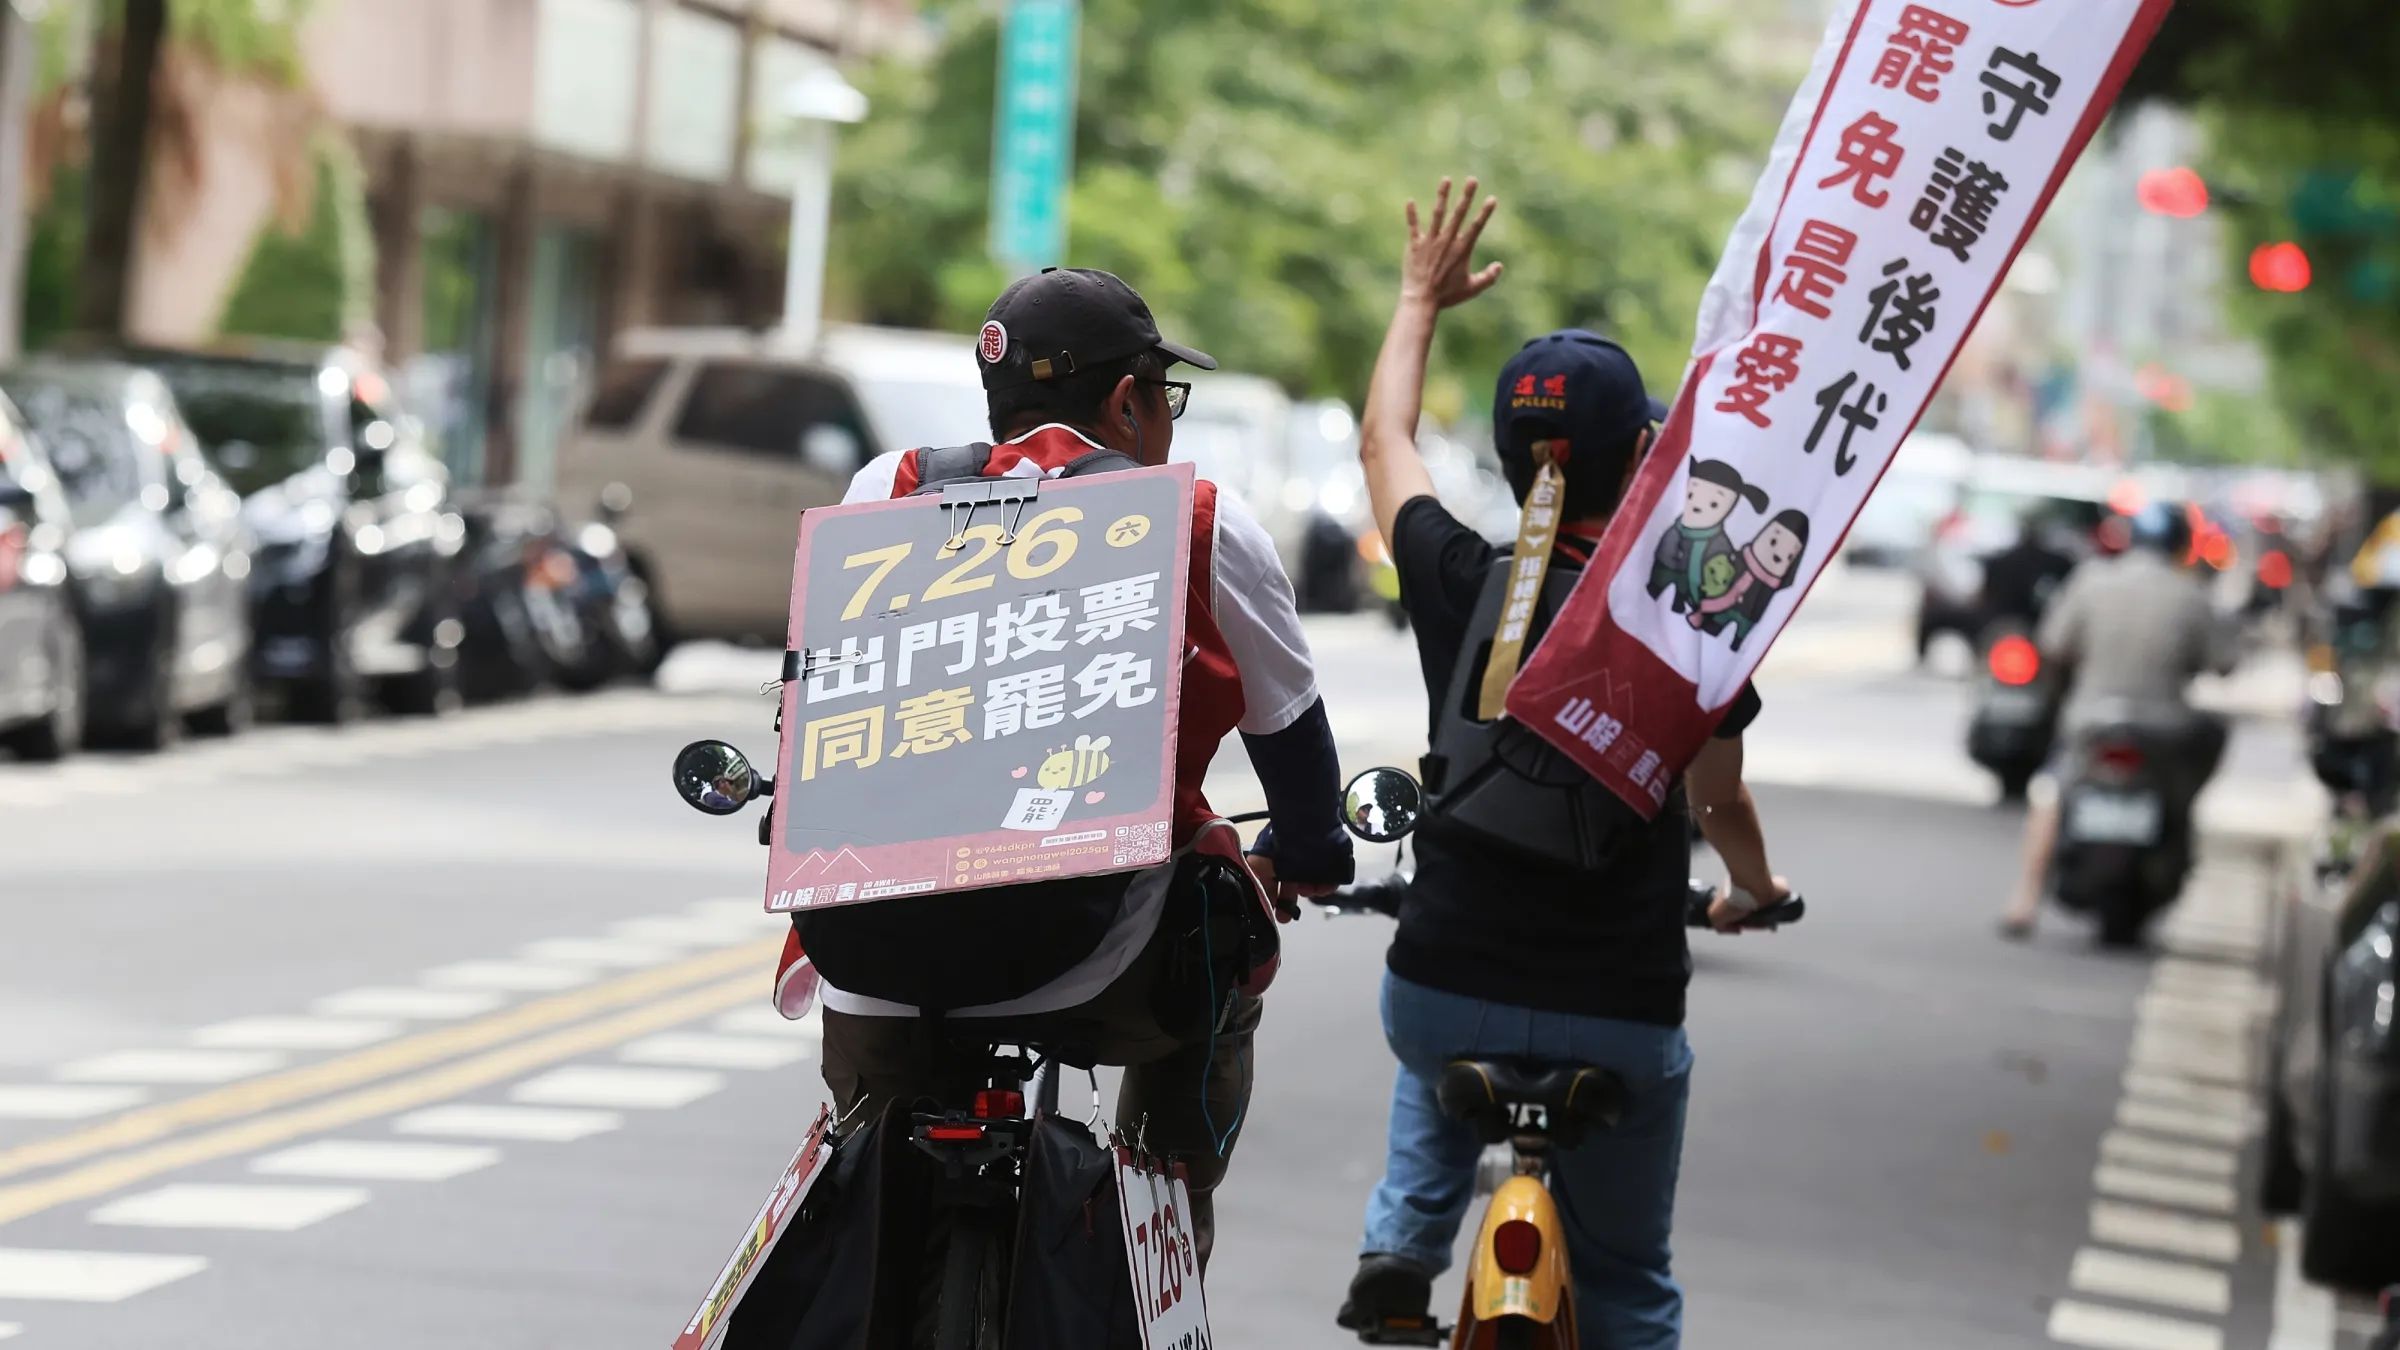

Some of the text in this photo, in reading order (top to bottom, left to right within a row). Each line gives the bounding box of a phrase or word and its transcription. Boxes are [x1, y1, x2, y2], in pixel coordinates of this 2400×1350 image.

[1715, 4, 1970, 429] 罷免是愛
[1804, 46, 2061, 476] 守護後代
[983, 328, 1001, 357] 罷
[840, 506, 1084, 622] 7.26
[806, 572, 1160, 705] 出門投票
[801, 651, 1157, 781] 同意罷免
[874, 878, 897, 887] AWAY
[1136, 1204, 1182, 1323] 7.26
